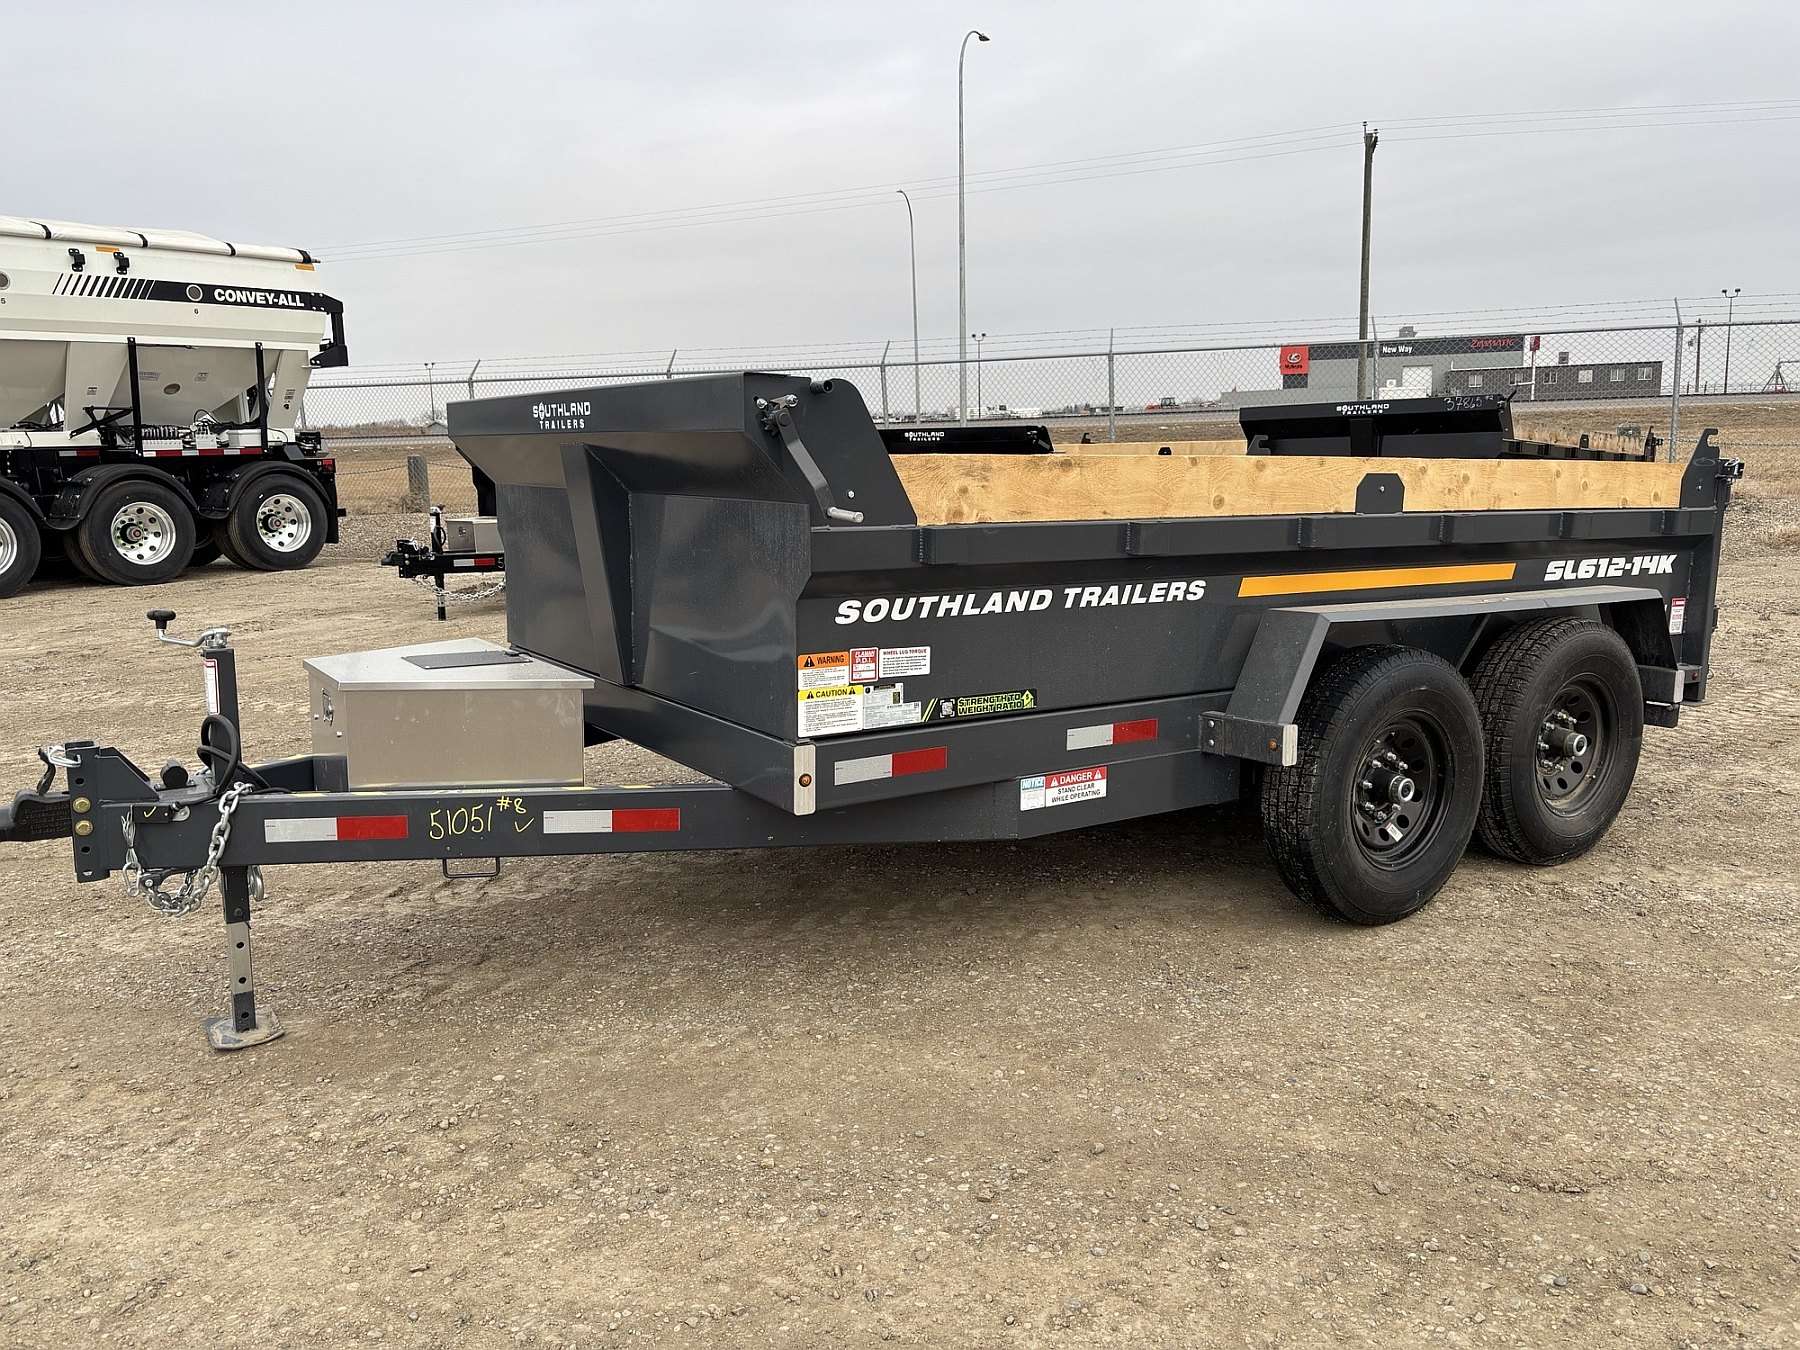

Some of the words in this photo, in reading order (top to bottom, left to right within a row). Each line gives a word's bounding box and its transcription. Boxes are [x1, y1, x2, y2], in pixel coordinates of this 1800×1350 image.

[213, 288, 305, 307] CONVEY-ALL
[1382, 345, 1397, 354] New
[1398, 345, 1413, 354] Way
[532, 401, 591, 420] SOUTHLAND
[540, 418, 585, 430] TRAILERS
[1543, 554, 1677, 582] SL612-14K
[835, 589, 1053, 625] SOUTHLAND
[1062, 580, 1207, 610] TRAILERS
[816, 655, 845, 665] WARNING
[815, 689, 848, 698] CAUTION
[958, 693, 1007, 707] STRENGTH
[1008, 692, 1022, 702] TO
[958, 704, 995, 716] WEIGHT
[995, 700, 1024, 711] RATIO
[1059, 772, 1093, 785] DANGER
[1057, 785, 1076, 795] STAND
[1076, 782, 1095, 793] CLEAR
[1051, 795, 1069, 804] WHILE
[1069, 789, 1101, 800] OPERATING
[429, 803, 493, 840] 51051
